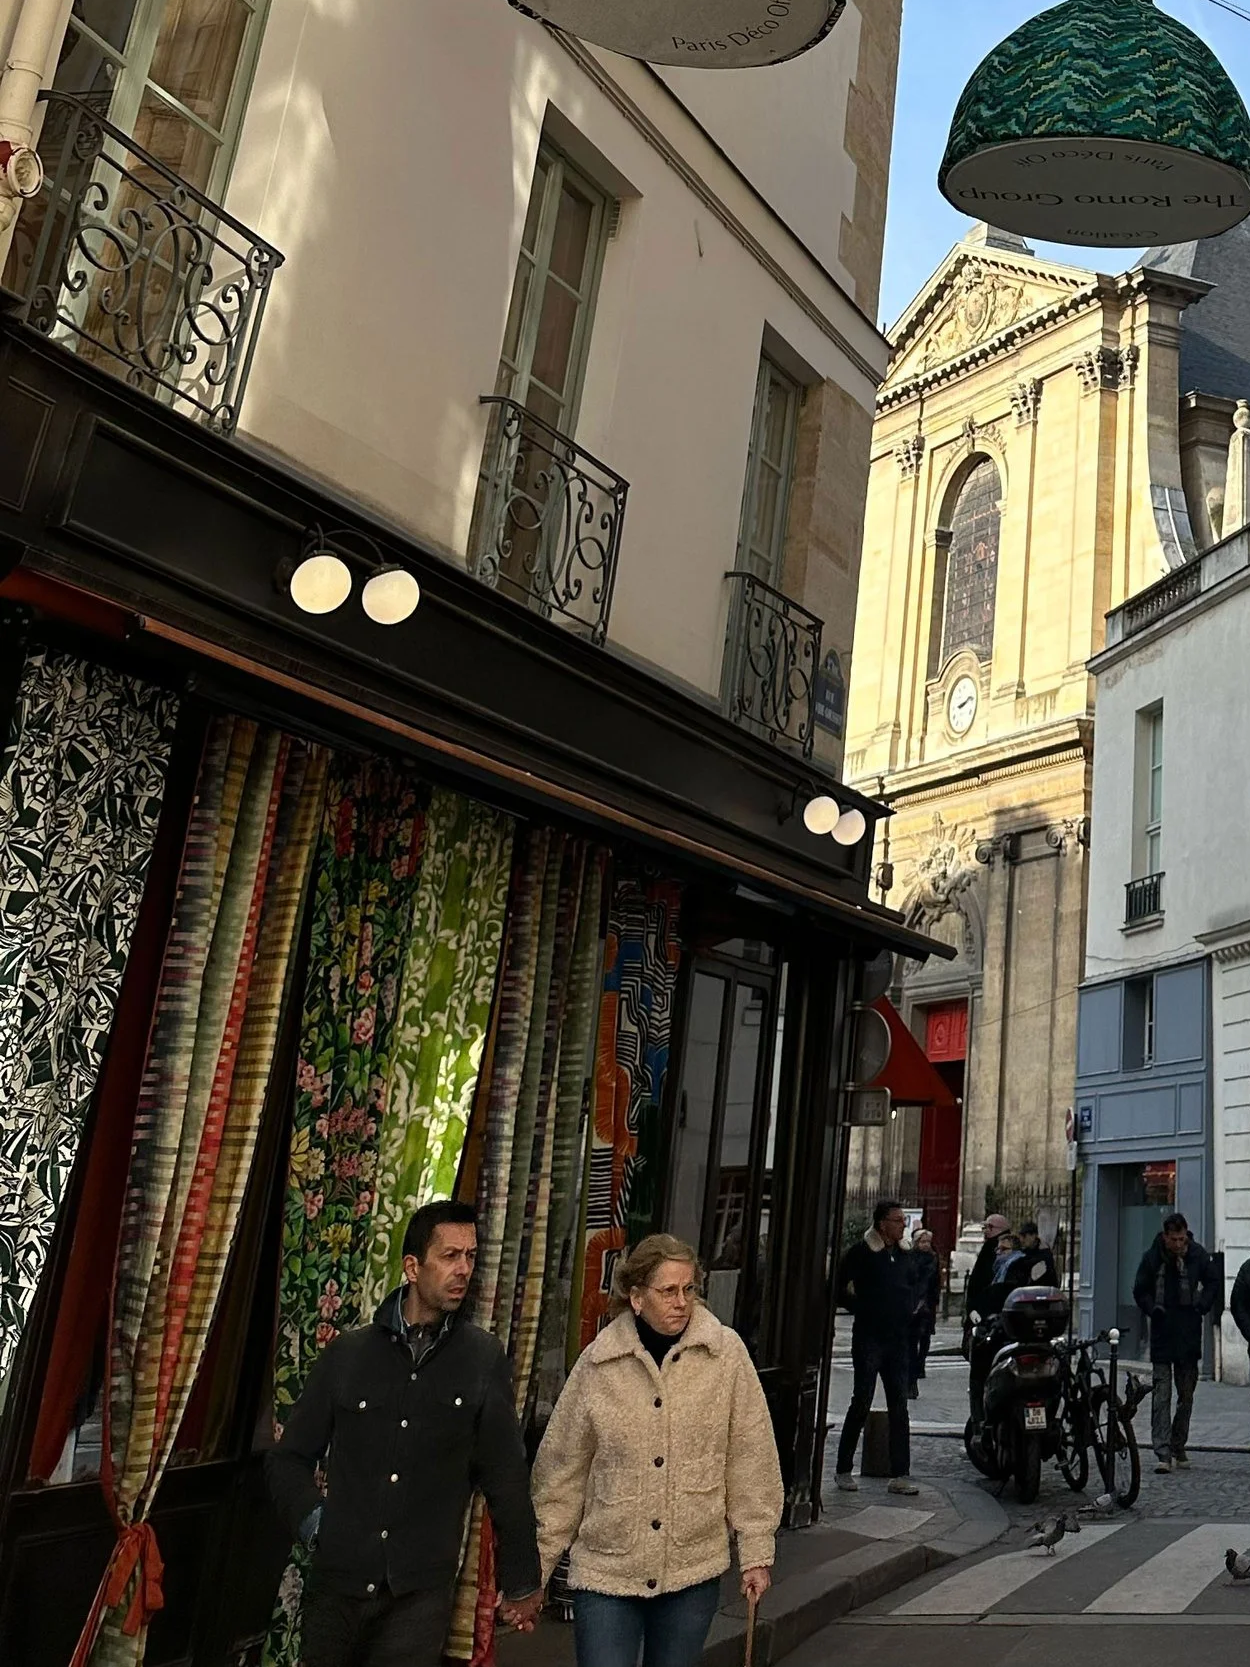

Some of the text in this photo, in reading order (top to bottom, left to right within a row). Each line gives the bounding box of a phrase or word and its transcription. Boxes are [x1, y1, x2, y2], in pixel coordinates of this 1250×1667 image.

[672, 35, 727, 53] Paris
[728, 18, 781, 48] Déco
[958, 186, 1243, 208] The Romo Group
